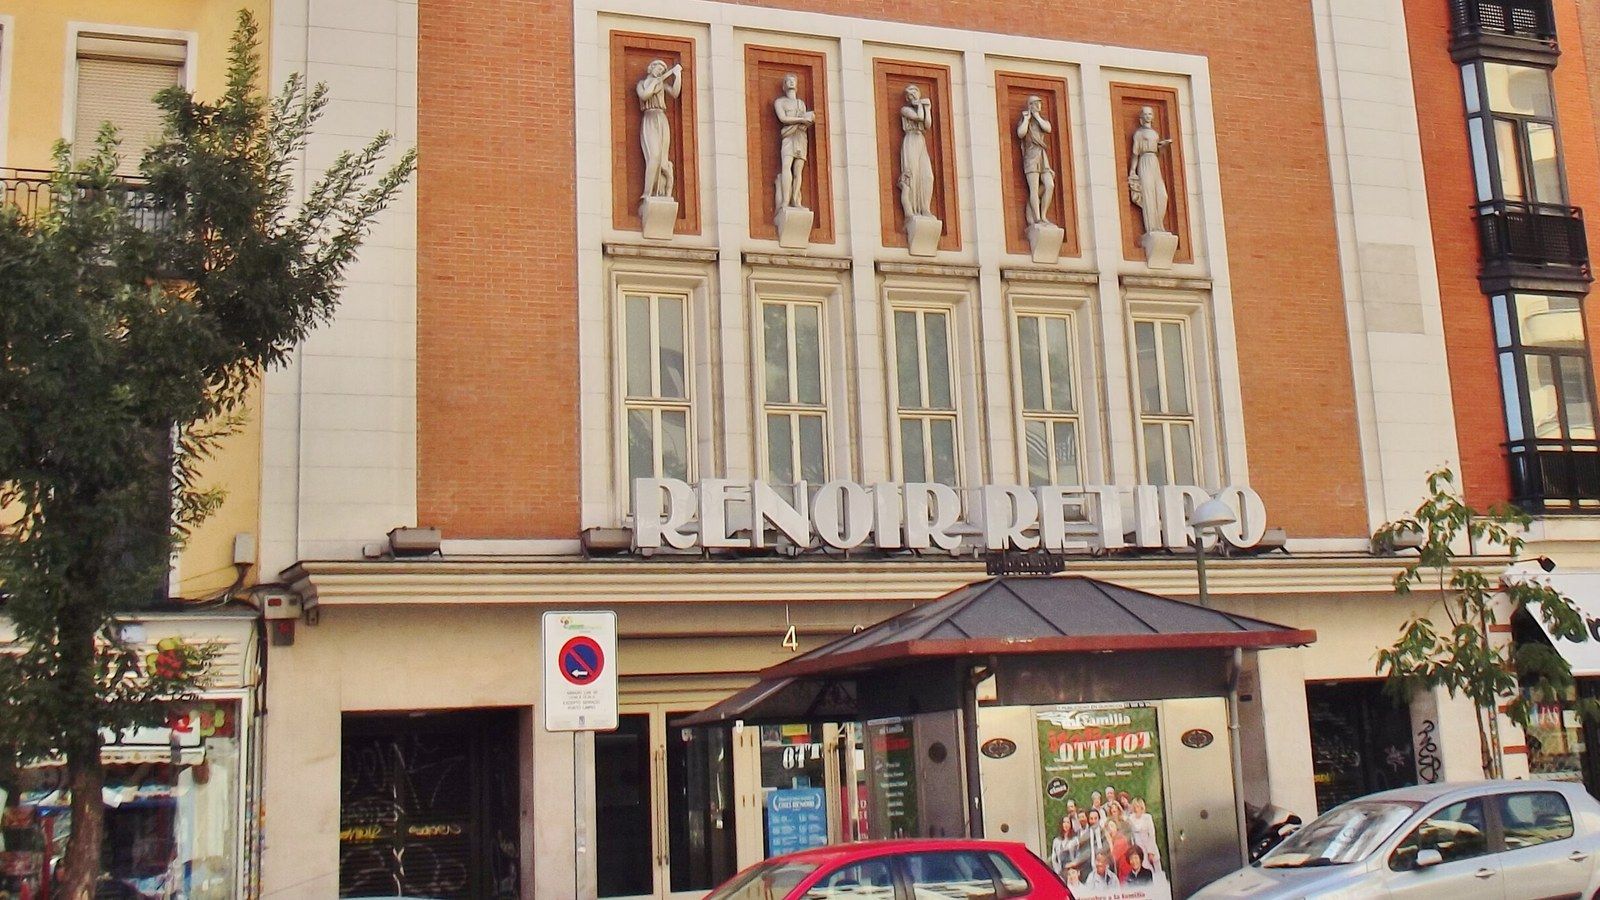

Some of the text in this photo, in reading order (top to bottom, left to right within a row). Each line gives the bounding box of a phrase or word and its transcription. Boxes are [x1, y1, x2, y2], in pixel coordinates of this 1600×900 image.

[633, 477, 1268, 551] RENOIR RETIRO
[782, 625, 799, 652] 4
